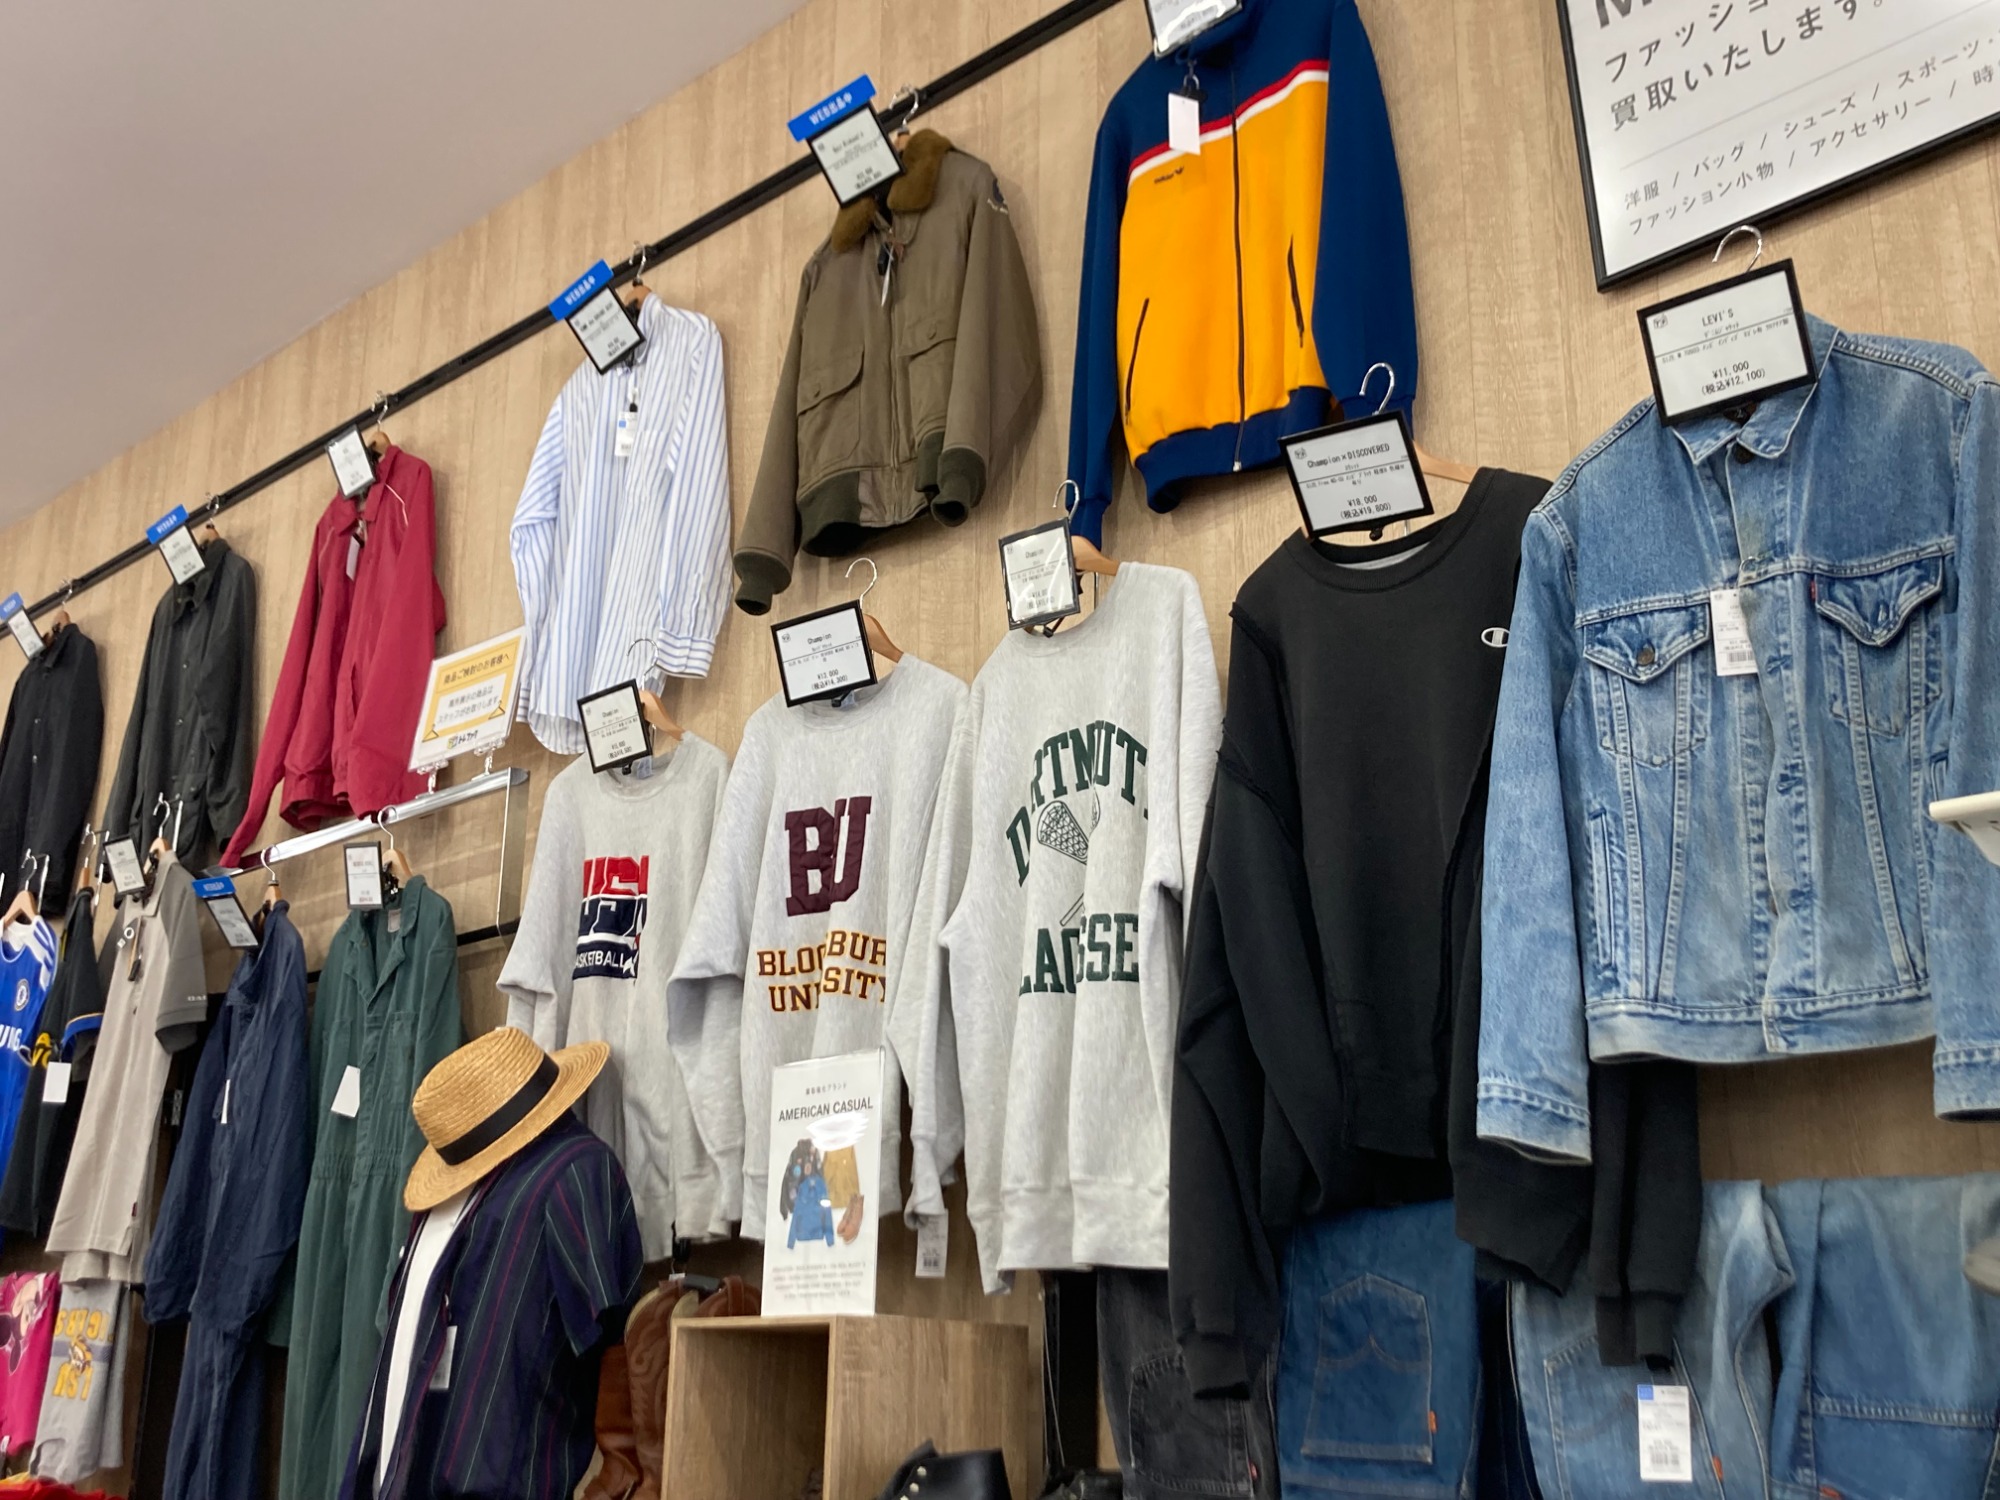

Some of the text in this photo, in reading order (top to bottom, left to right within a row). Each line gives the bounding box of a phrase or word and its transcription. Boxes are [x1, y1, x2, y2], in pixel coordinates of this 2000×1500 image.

[1625, 180, 1660, 210] 洋服
[1694, 141, 1745, 177] バッグ
[1784, 91, 1857, 139] シューズ
[1898, 29, 2000, 89] スポーツ・
[1629, 161, 1774, 235] ファッション小物
[1810, 97, 1931, 158] アクセサリー
[1972, 58, 2000, 87] 時
[1701, 308, 1734, 327] LEVI'S
[1701, 368, 1766, 396] (税込¥12,100)
[1712, 360, 1749, 380] ¥11,000
[785, 796, 872, 917] BU
[778, 1096, 873, 1122] AMERICAN CASUAL
